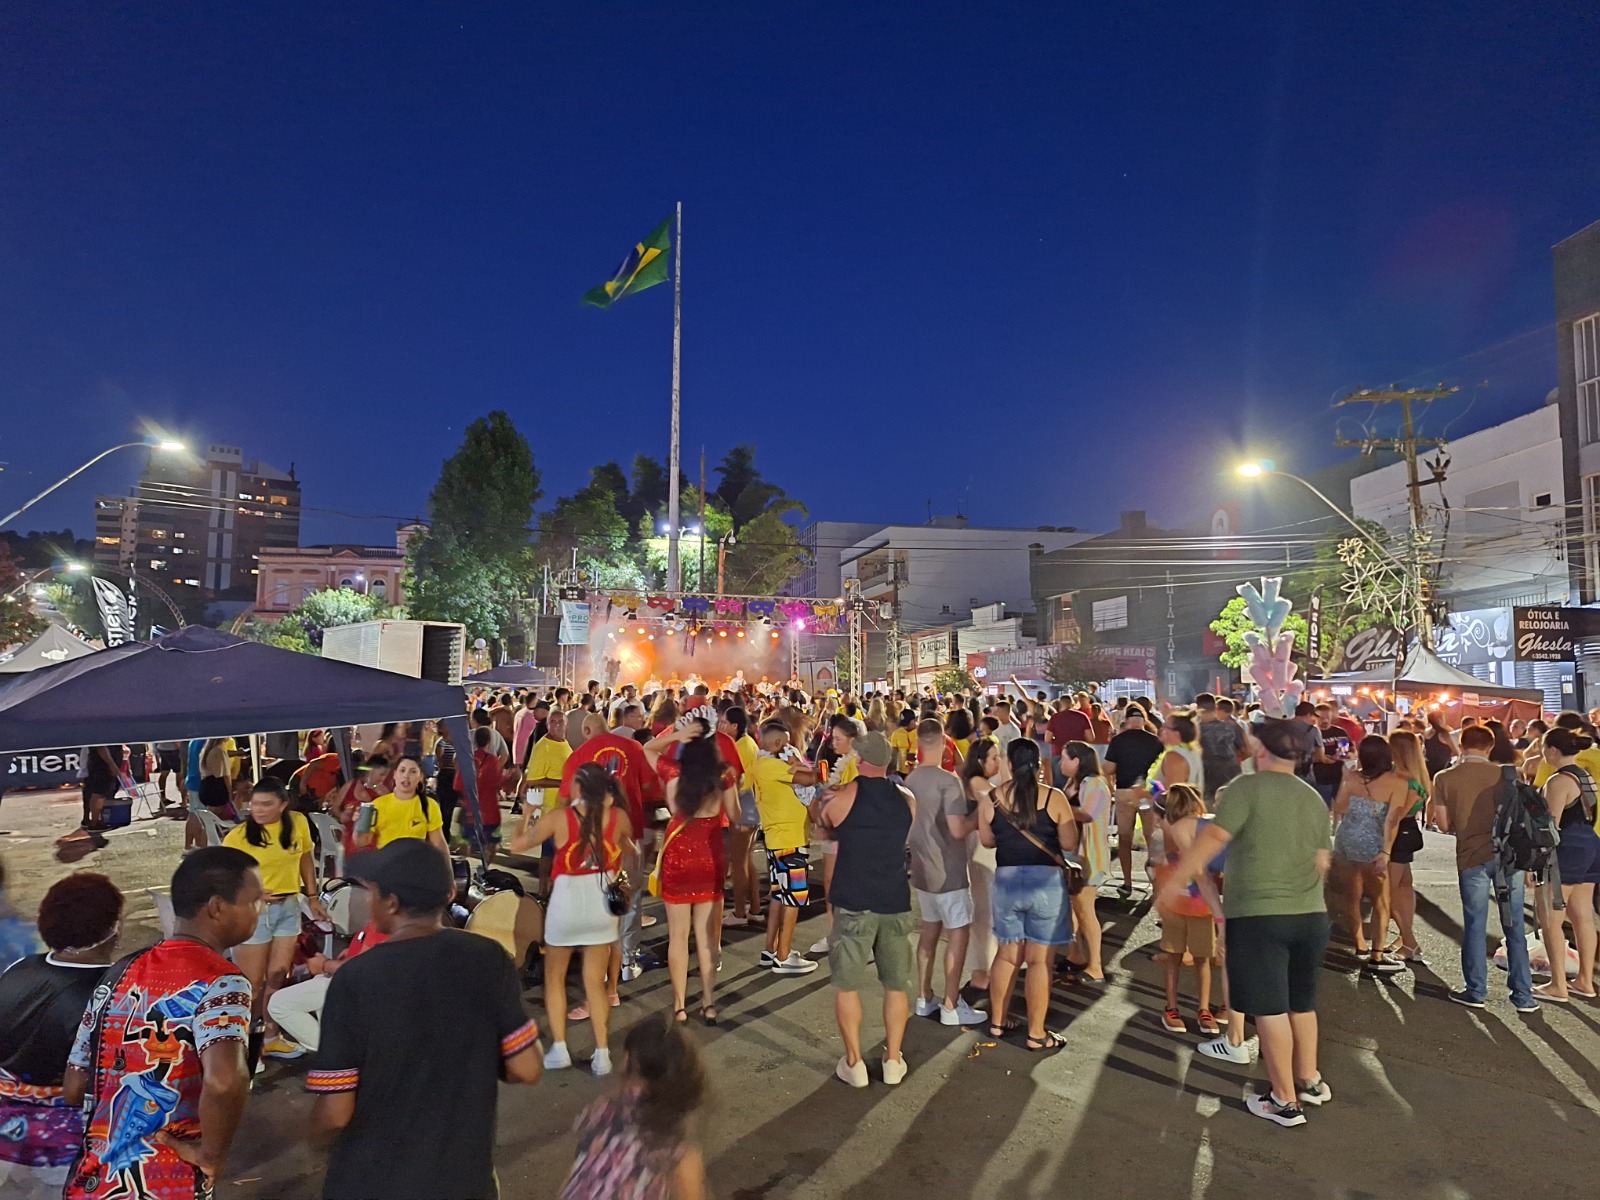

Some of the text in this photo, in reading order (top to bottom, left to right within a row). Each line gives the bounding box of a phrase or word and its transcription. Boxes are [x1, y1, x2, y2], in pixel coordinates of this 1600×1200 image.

[1527, 609, 1560, 620] ÓTICA E
[1519, 620, 1570, 630] RELOJOARIA
[1517, 632, 1573, 657] Ghesla
[987, 650, 1032, 671] SHOPPING
